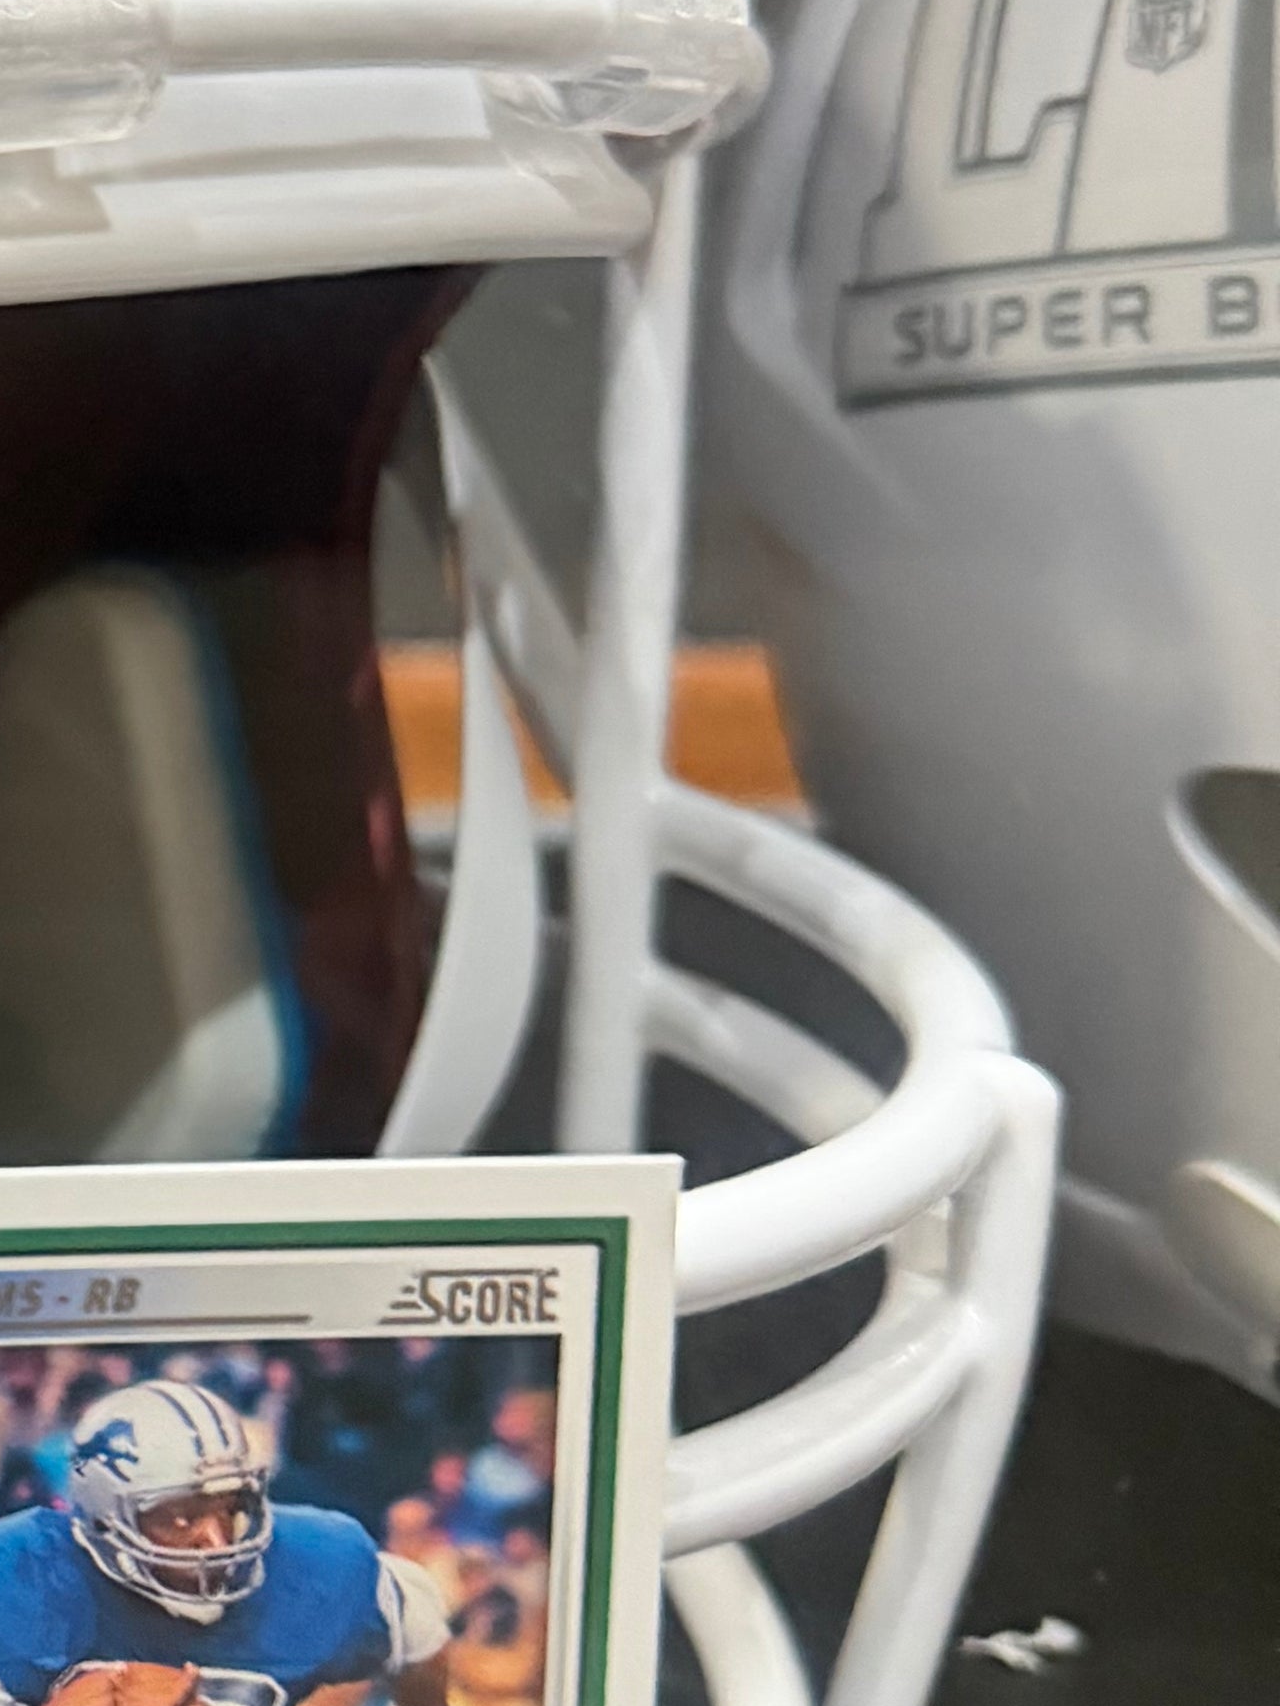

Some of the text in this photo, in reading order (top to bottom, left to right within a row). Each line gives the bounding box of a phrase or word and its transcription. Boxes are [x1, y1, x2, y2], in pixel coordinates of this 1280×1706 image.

[893, 271, 1280, 367] SUPER B
[82, 1276, 142, 1315] RB
[378, 1266, 561, 1325] SCORE
